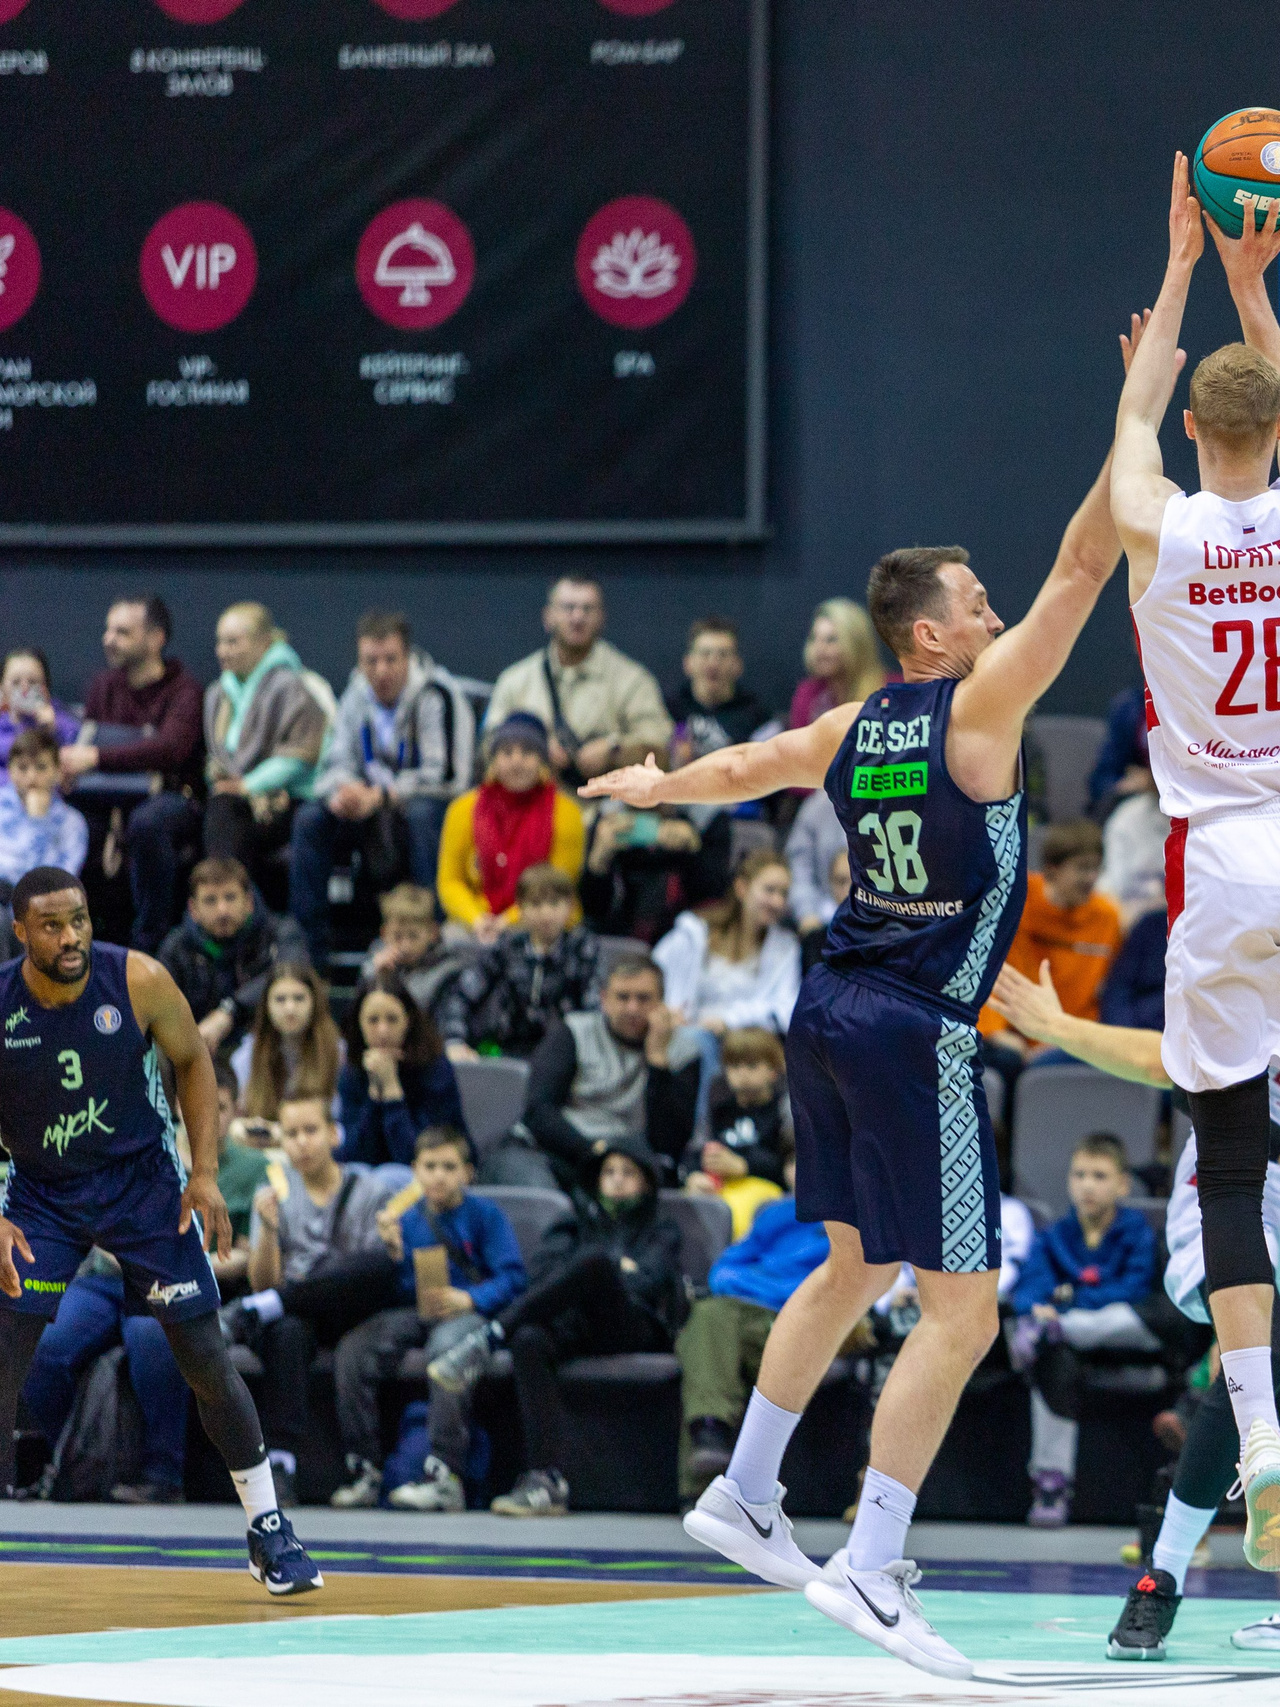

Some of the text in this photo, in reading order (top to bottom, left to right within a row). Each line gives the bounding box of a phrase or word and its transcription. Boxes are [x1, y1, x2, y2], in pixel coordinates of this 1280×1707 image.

[161, 243, 237, 290] VIP
[858, 810, 929, 894] 38
[4, 1035, 41, 1049] Kempa
[57, 1049, 83, 1090] 3
